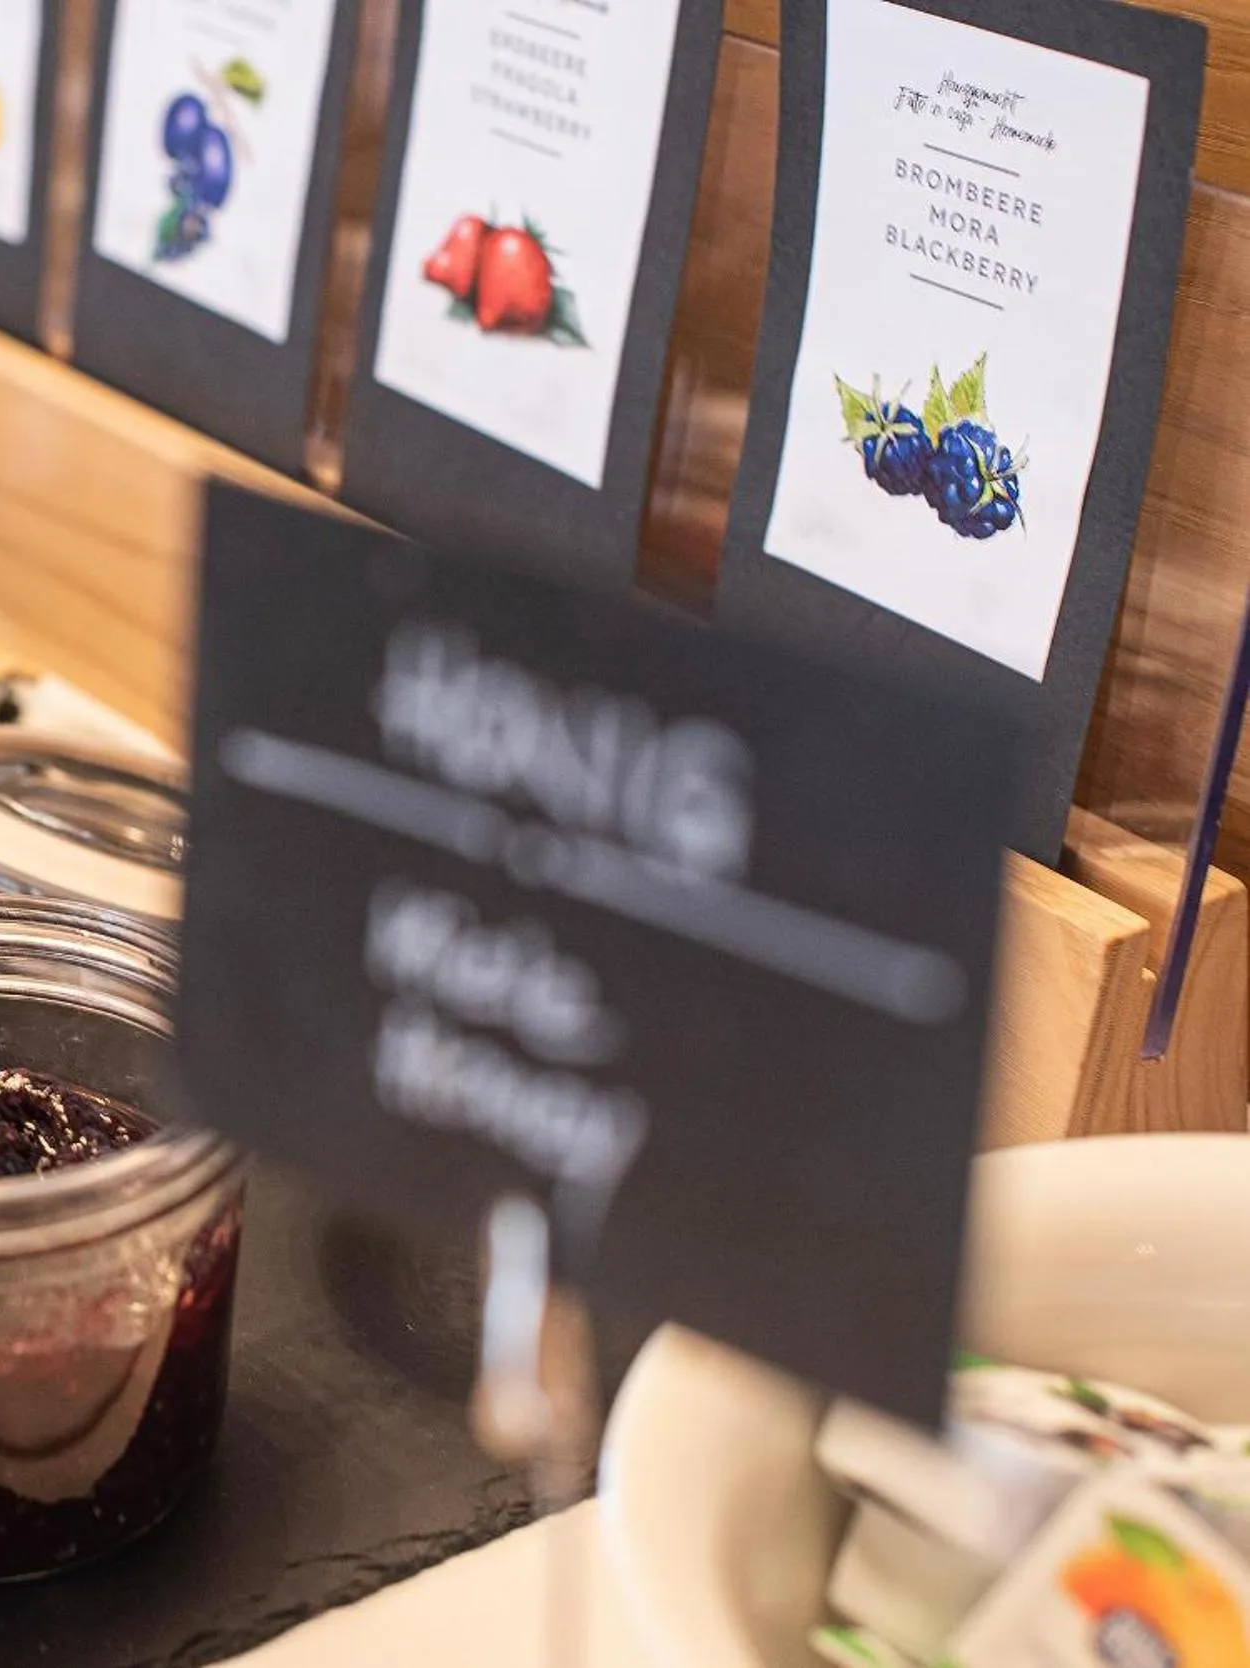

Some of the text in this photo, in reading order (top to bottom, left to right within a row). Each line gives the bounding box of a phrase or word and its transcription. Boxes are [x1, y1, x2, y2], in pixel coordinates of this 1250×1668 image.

[895, 158, 1043, 226] BROMBEERE
[928, 202, 1000, 246] MORA
[884, 223, 1039, 294] BLACKBERRY
